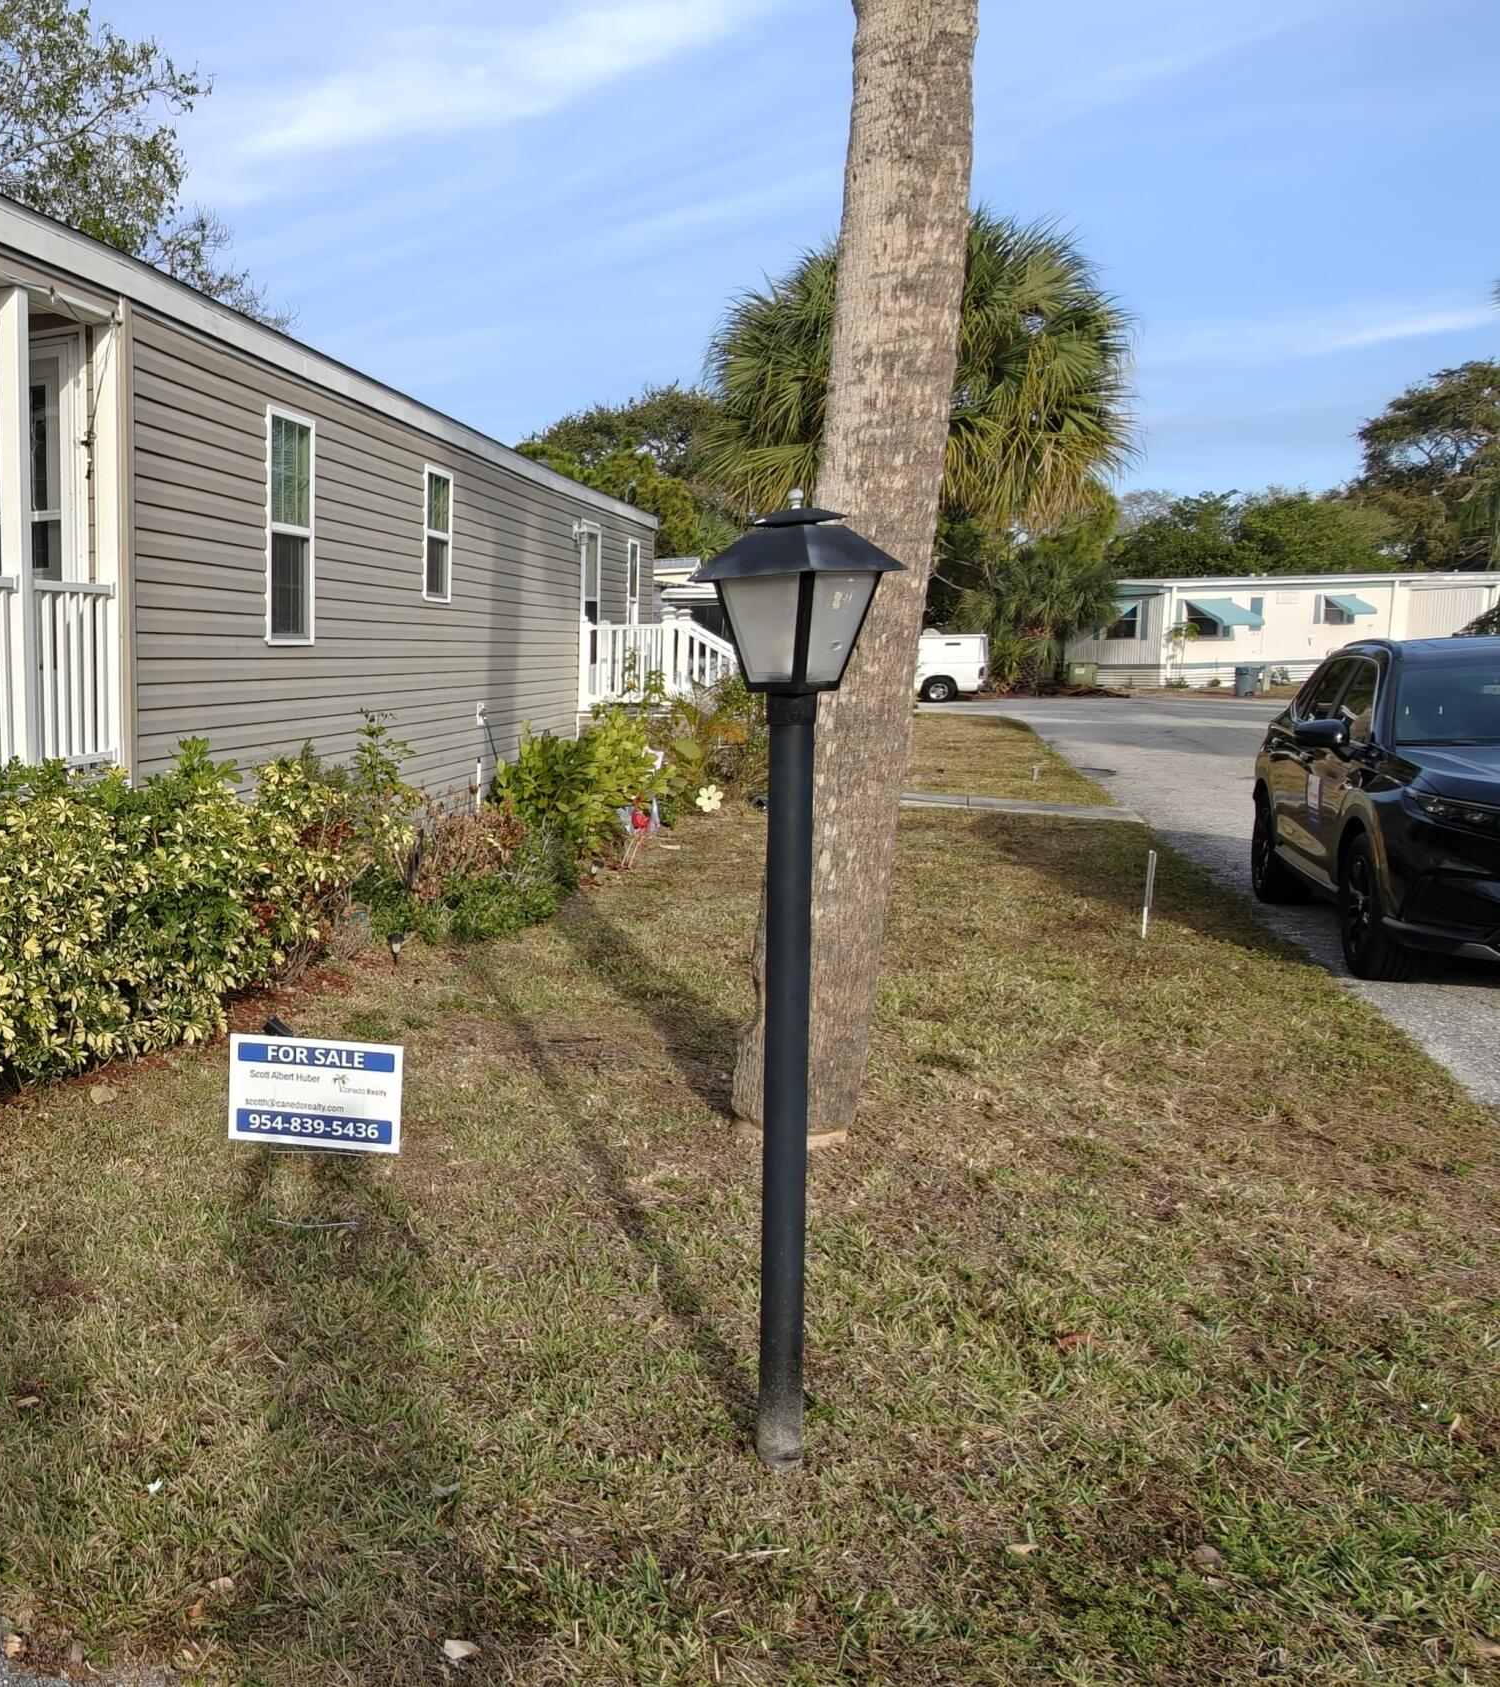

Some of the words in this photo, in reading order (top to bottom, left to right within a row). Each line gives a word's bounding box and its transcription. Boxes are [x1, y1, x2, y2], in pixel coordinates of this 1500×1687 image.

[267, 1045, 309, 1065] FOR
[314, 1049, 365, 1069] SALE
[249, 1069, 270, 1079] Scott
[271, 1071, 294, 1082] Albert
[295, 1073, 320, 1084] Huber
[366, 1088, 388, 1098] Realty
[245, 1097, 345, 1114] scotth@canedorealty.com
[248, 1113, 379, 1139] 954-839-5436
